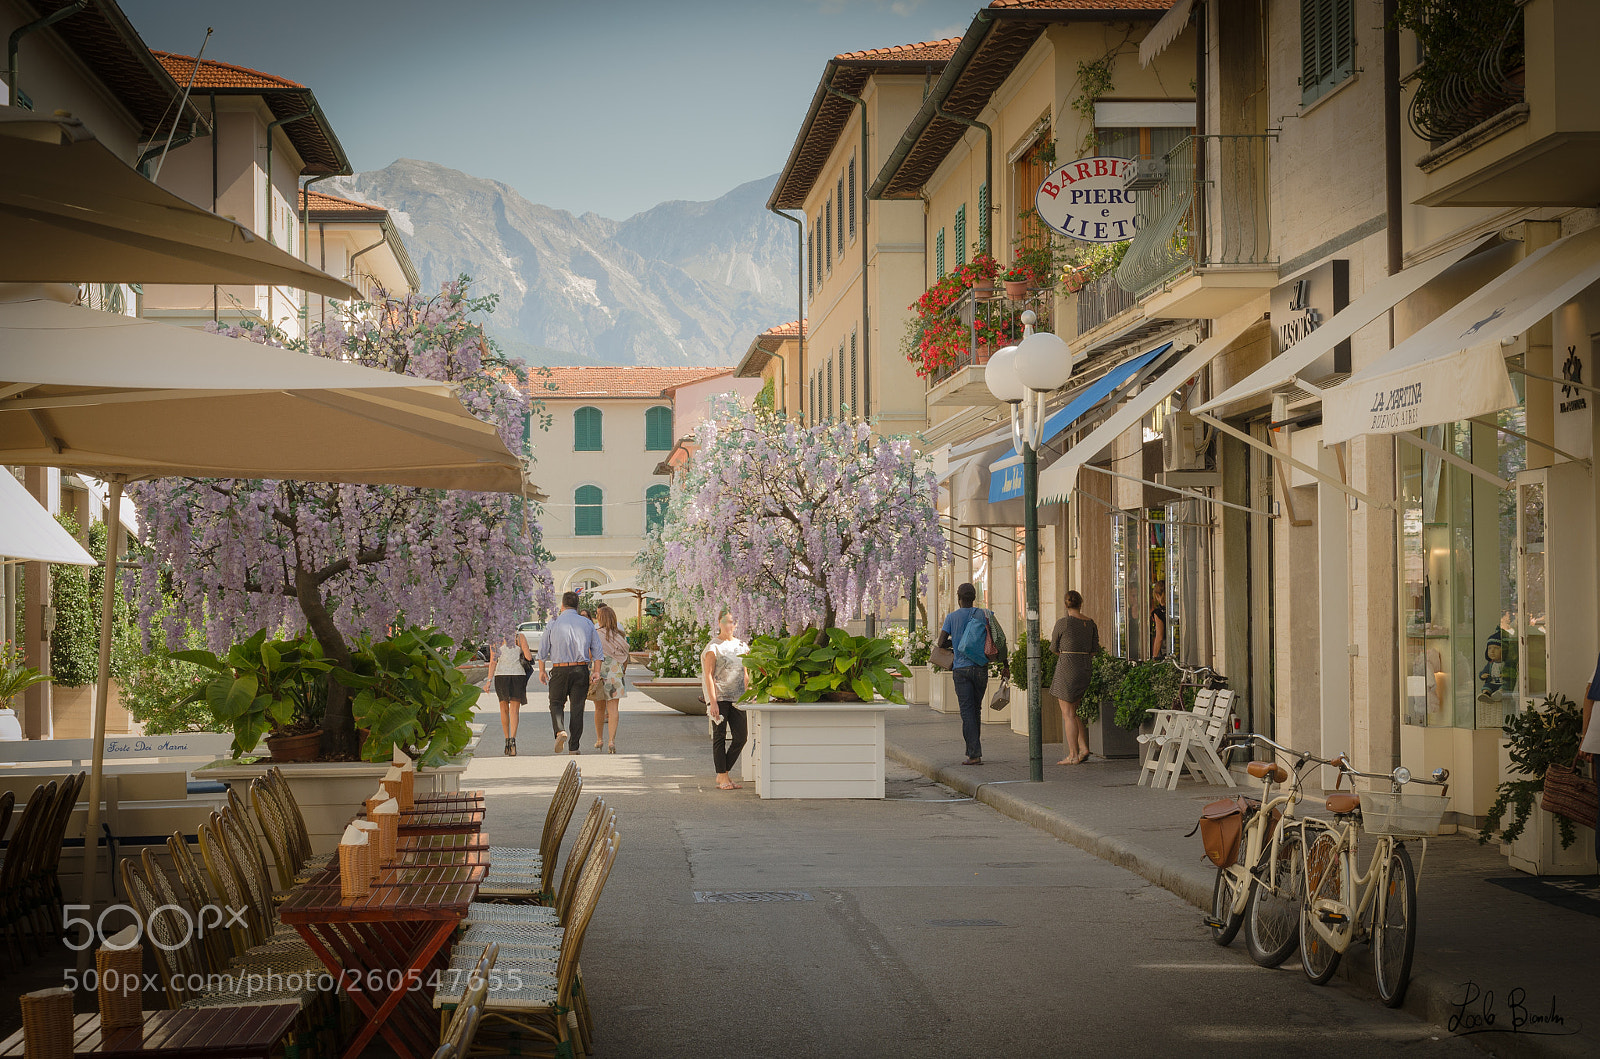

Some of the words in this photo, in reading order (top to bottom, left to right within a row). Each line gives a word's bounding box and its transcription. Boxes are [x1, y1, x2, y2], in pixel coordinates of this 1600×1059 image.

[1100, 208, 1110, 218] e
[1370, 391, 1385, 413] LA
[1385, 382, 1422, 411] MARTINA
[1371, 411, 1400, 430] BUENOS
[1400, 407, 1419, 427] AIRES
[106, 741, 131, 753] Forte
[134, 740, 153, 752] Dei
[157, 740, 189, 751] Marmi
